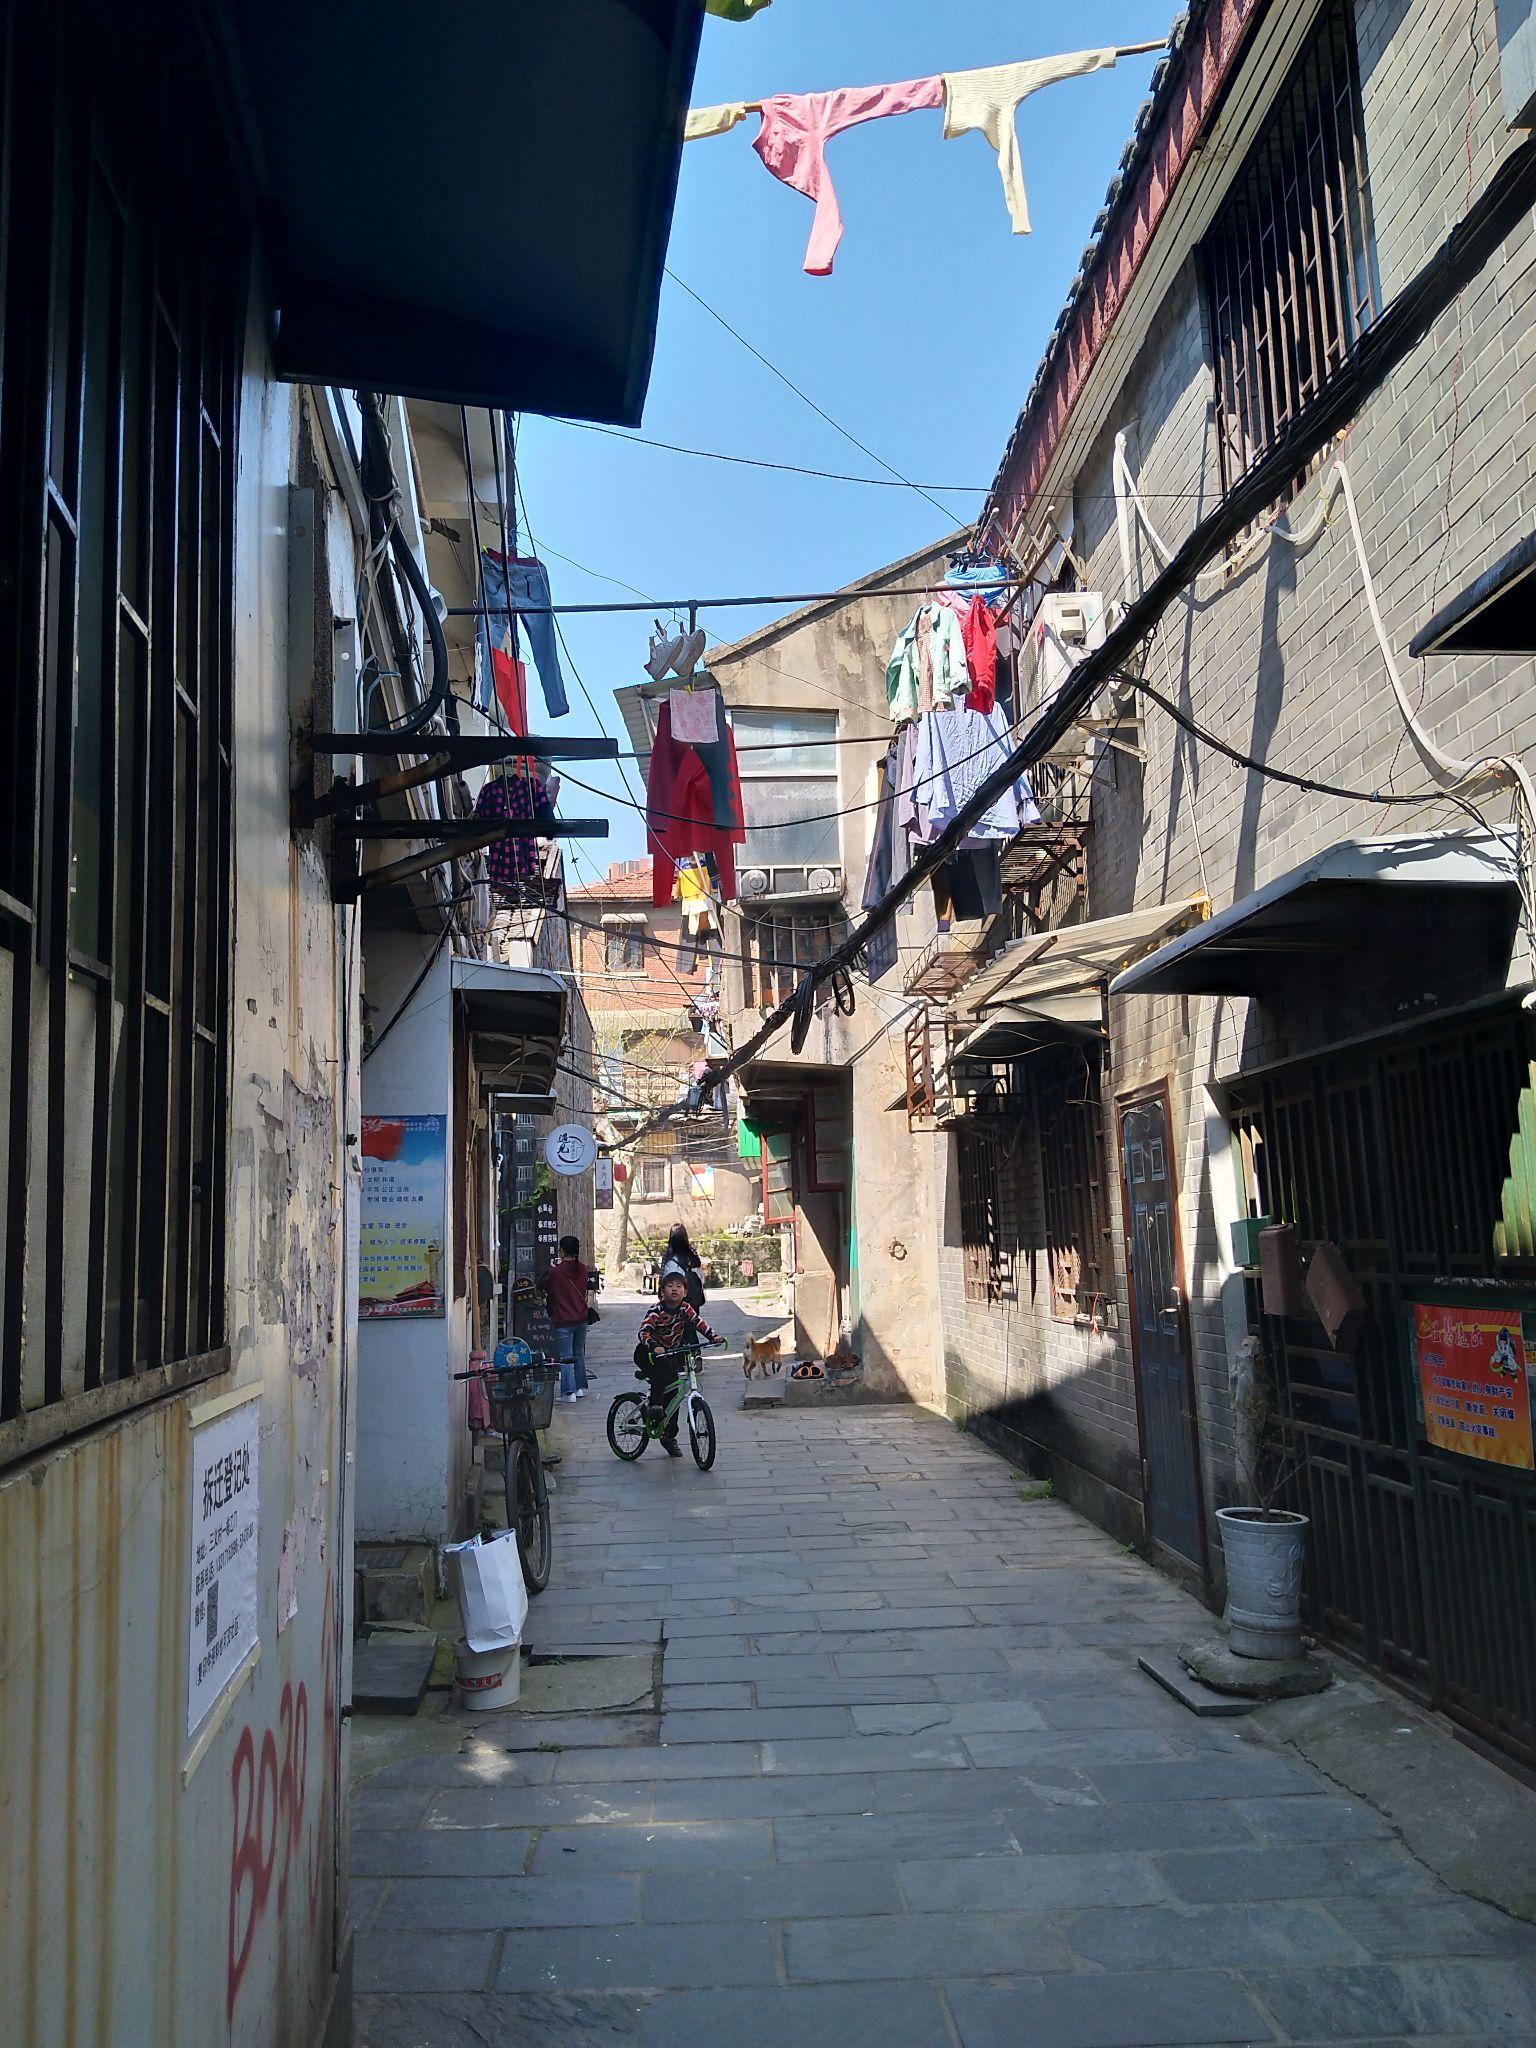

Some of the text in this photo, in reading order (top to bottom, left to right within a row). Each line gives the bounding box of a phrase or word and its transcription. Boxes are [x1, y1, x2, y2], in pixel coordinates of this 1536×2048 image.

[203, 1440, 250, 1523] 拆迁登记处
